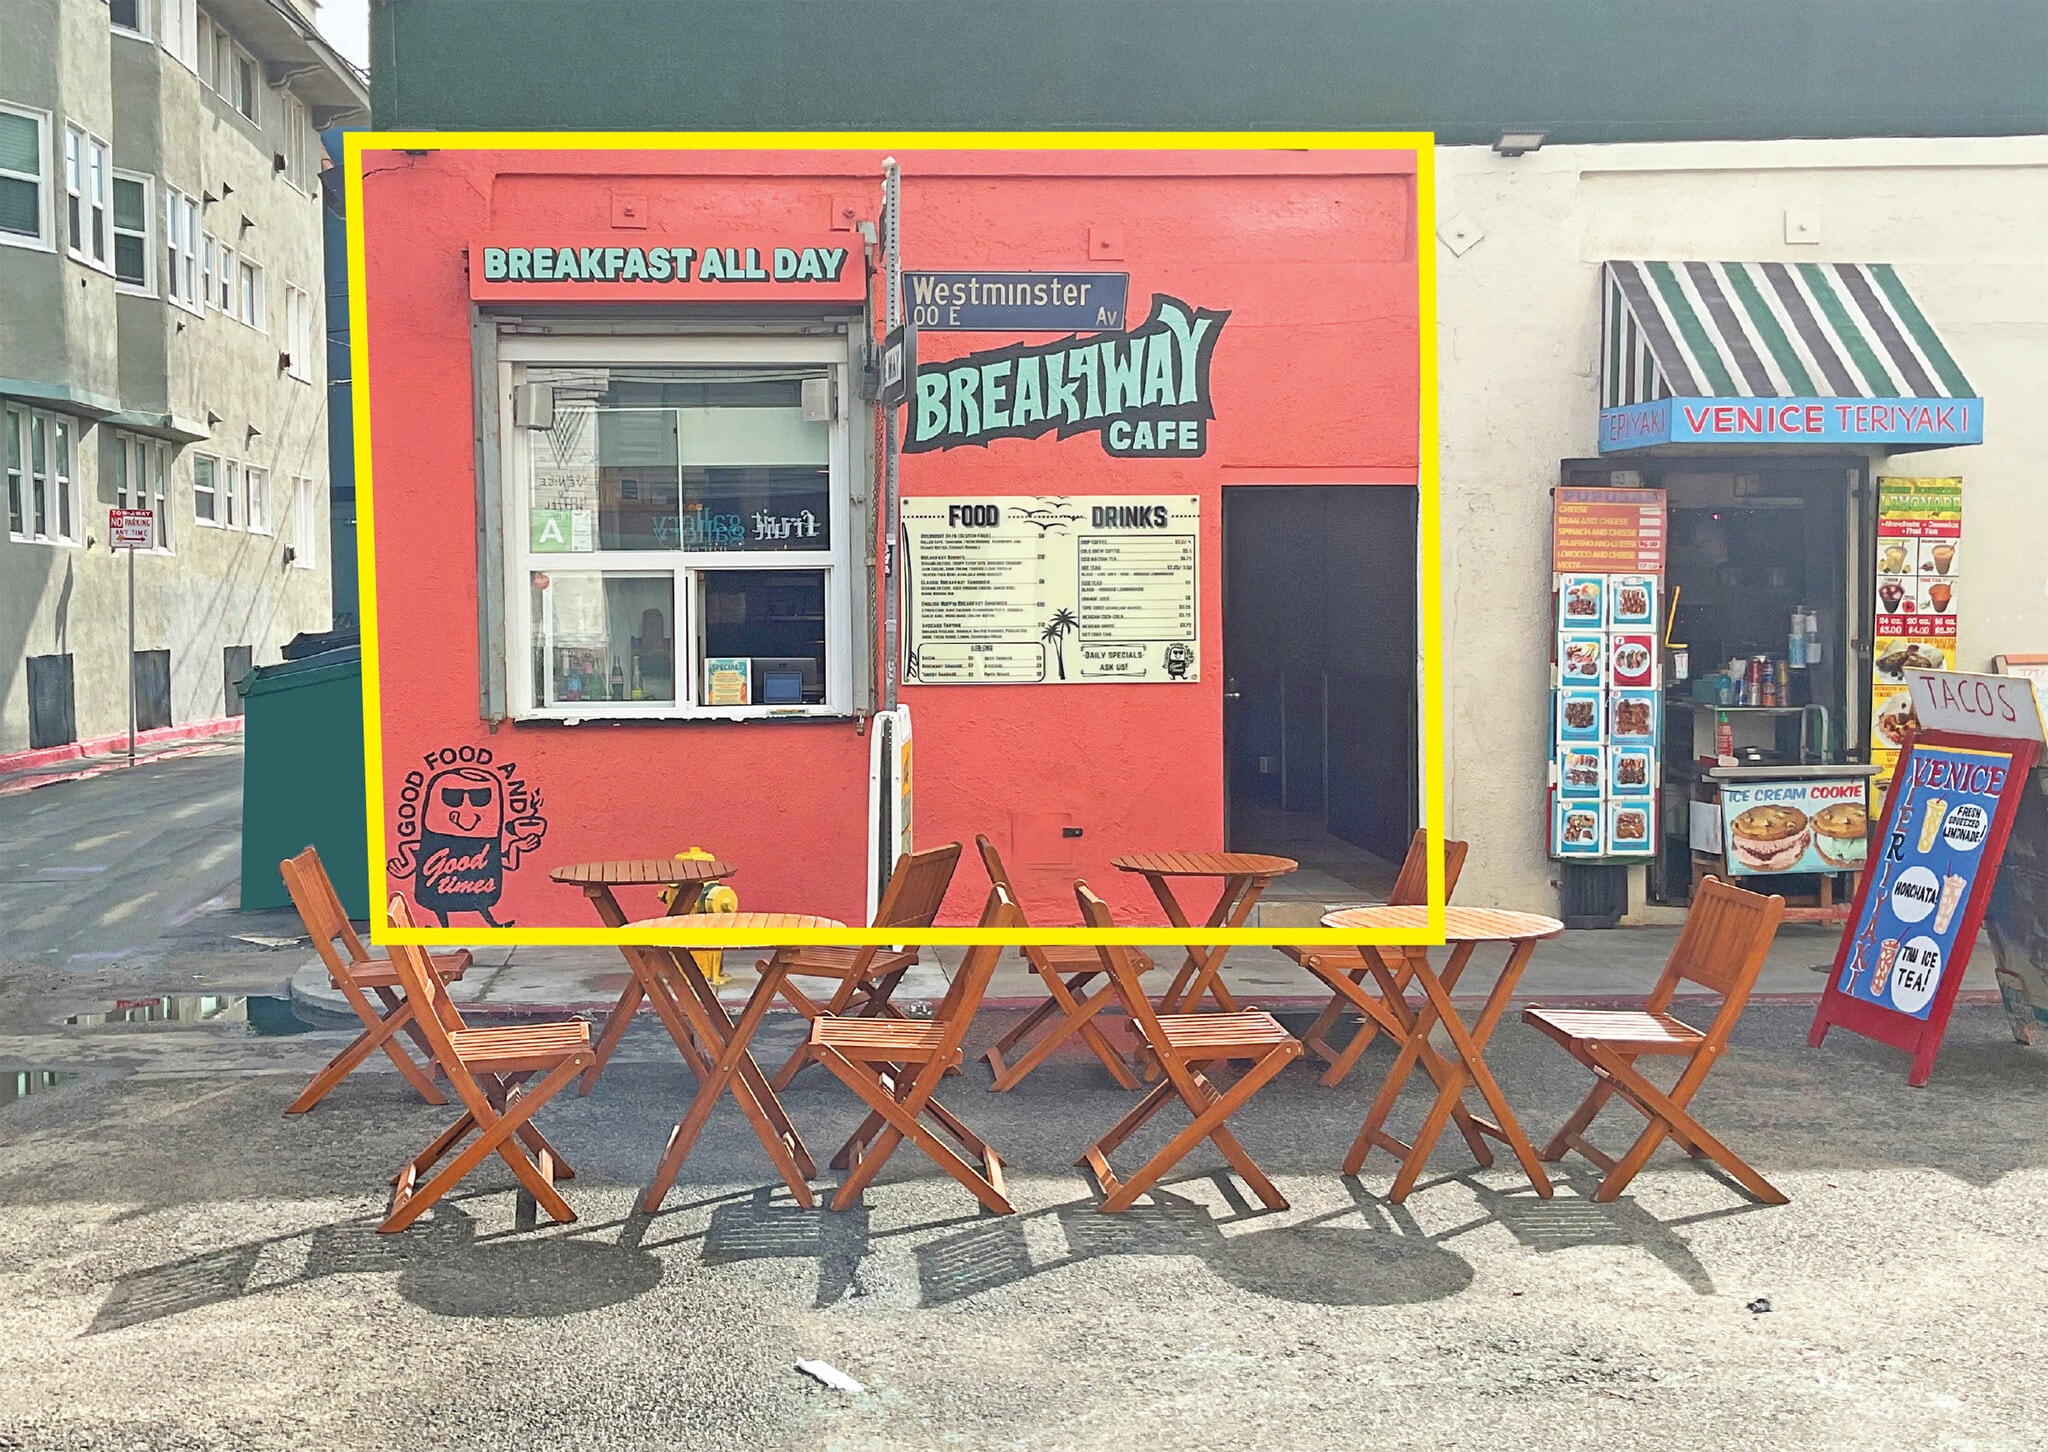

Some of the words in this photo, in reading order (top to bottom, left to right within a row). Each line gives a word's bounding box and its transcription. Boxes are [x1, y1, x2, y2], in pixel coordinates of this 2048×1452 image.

[483, 246, 697, 283] BREAKFAST
[700, 246, 769, 283] ALL
[774, 246, 848, 283] DAY
[913, 275, 1092, 308] Westminster
[949, 306, 961, 326] E
[1095, 308, 1118, 327] Av
[916, 303, 1213, 442] BREAKAWAY
[1601, 406, 1667, 442] TERIYAKI
[1683, 405, 1824, 434] VENICE
[1834, 405, 1969, 433] TERIYAKI
[1109, 420, 1199, 450] CAFE
[1559, 505, 1589, 513] CHEESE
[1880, 495, 1961, 511] LEMONADE
[111, 517, 123, 528] NO
[124, 518, 150, 527] PARKING
[949, 505, 1000, 528] FOOD
[1092, 505, 1168, 529] DRINKS
[1558, 517, 1579, 525] BEAN
[1599, 517, 1629, 525] CHEESE
[538, 517, 565, 544] A
[1085, 651, 1106, 659] DAILY
[1108, 651, 1143, 659] SPECIALS
[1116, 663, 1128, 671] US!
[1919, 676, 2016, 722] TACOS
[1912, 756, 2007, 799] VENICE
[398, 770, 424, 837] GOOD
[424, 746, 493, 771] FOOD
[497, 763, 528, 814] AND
[1729, 788, 1750, 802] ICE
[1754, 787, 1807, 801] CREAM
[1810, 785, 1862, 799] COOKIE
[1957, 806, 1981, 819] FRESH
[423, 844, 490, 887] Good
[437, 876, 496, 895] times
[1921, 950, 1938, 968] ICE
[1898, 968, 1931, 992] TEA!
